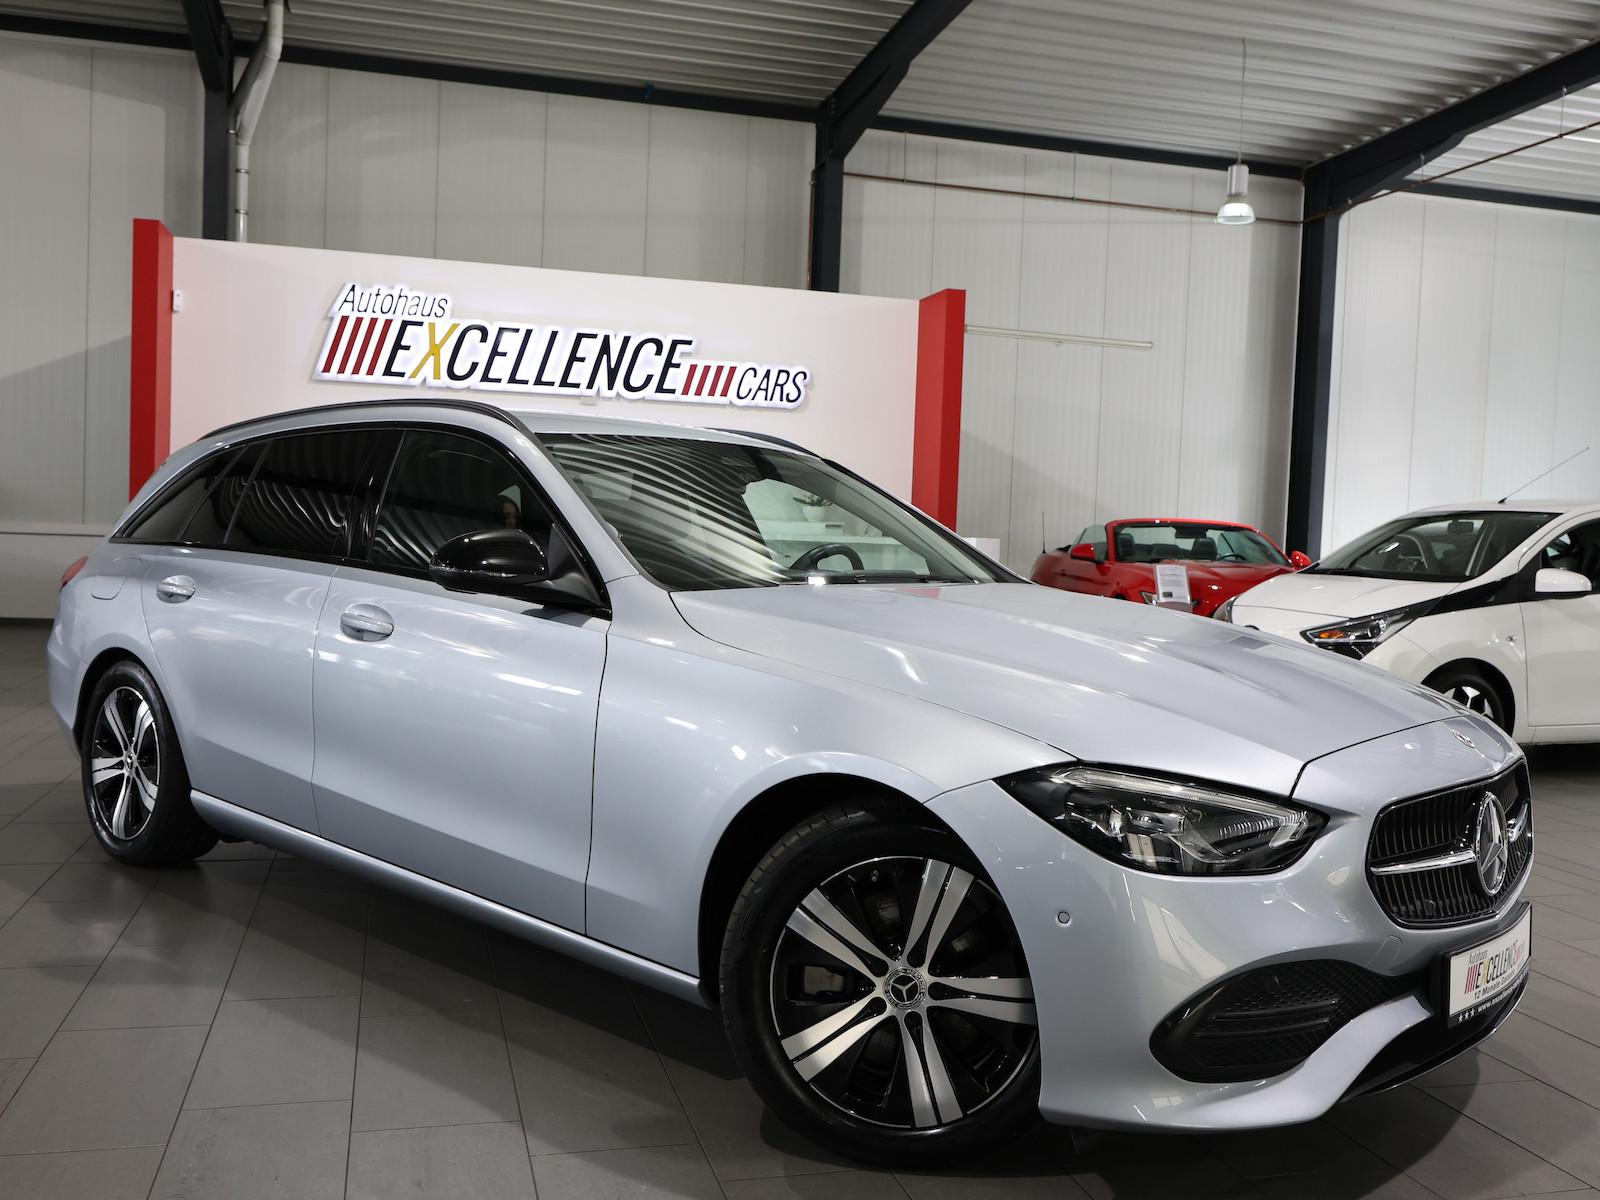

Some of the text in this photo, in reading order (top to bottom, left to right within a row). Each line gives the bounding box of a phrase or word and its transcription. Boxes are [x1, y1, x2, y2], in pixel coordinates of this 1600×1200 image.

[338, 284, 448, 318] Autohaus
[382, 319, 808, 403] EXCELLENCE CARS
